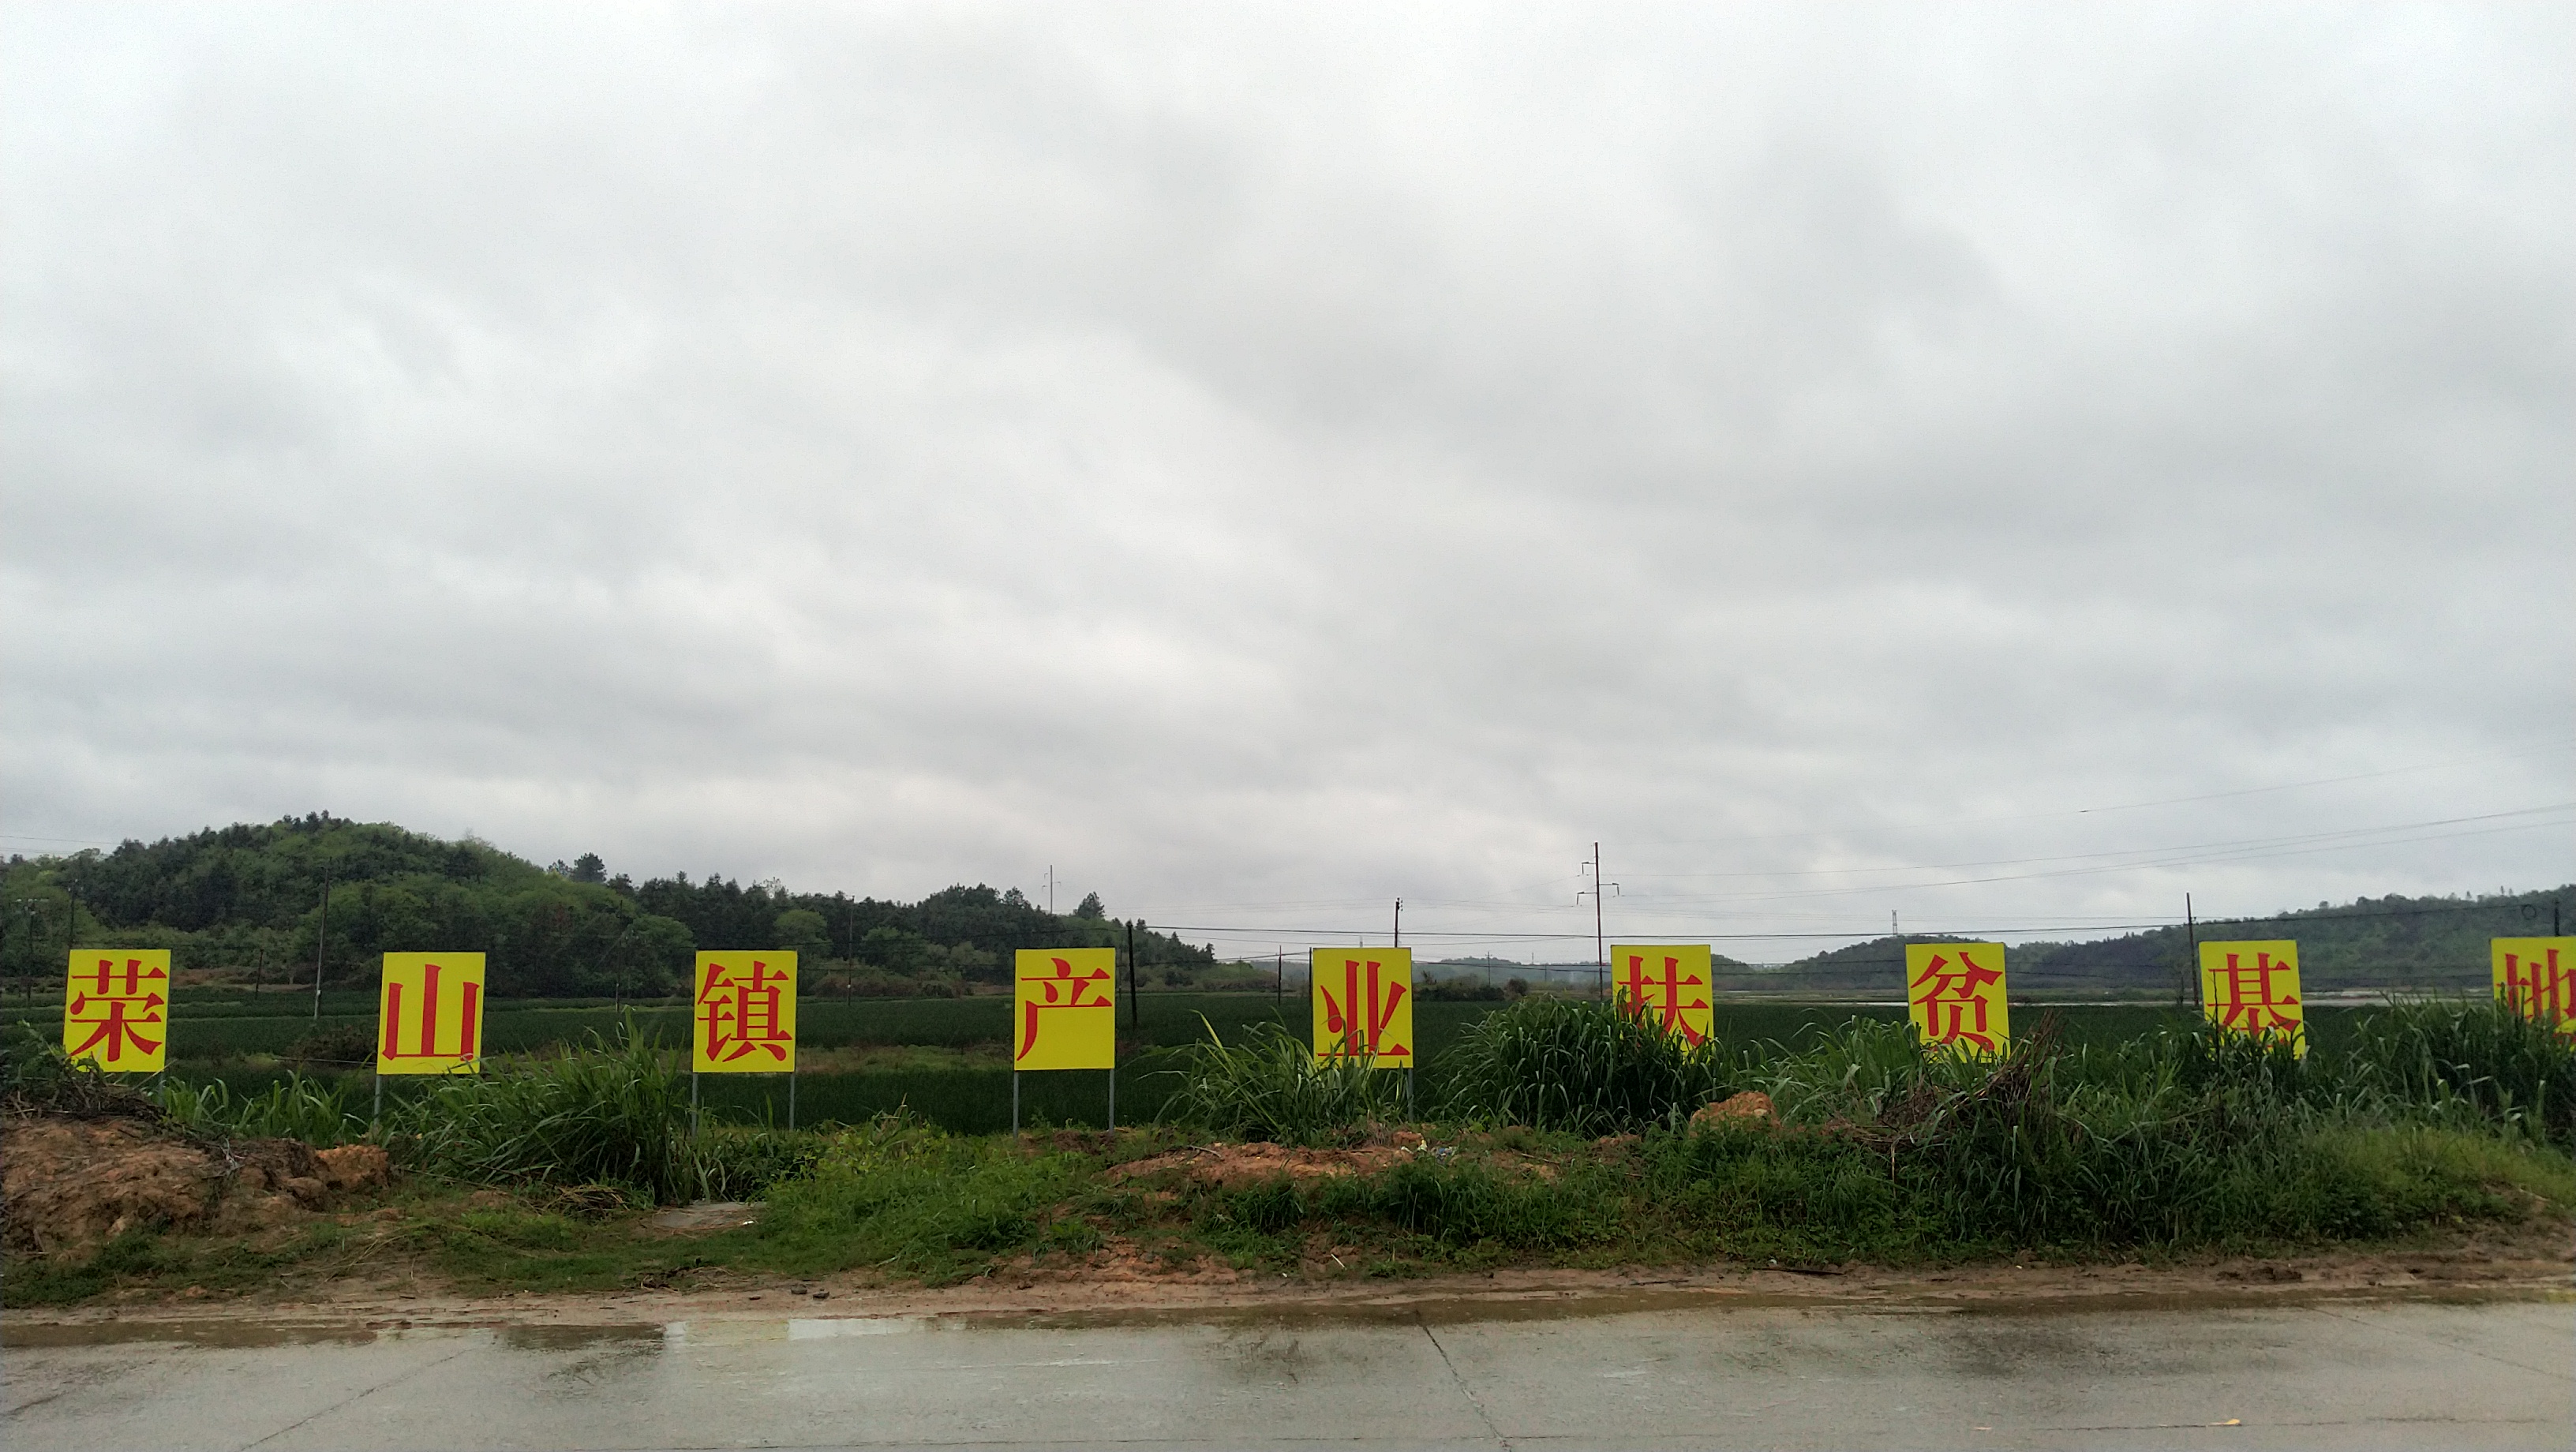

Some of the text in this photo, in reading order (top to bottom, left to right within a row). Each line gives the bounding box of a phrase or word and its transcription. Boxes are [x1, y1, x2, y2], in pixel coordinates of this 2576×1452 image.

[69, 959, 166, 1061] 荣
[382, 964, 479, 1061] 山
[697, 960, 792, 1061] 镇
[1017, 957, 1112, 1061] 产
[1318, 960, 1410, 1056] 业
[1616, 955, 1712, 1048] 扶
[1911, 952, 2003, 1053] 贫
[2207, 952, 2301, 1047] 基
